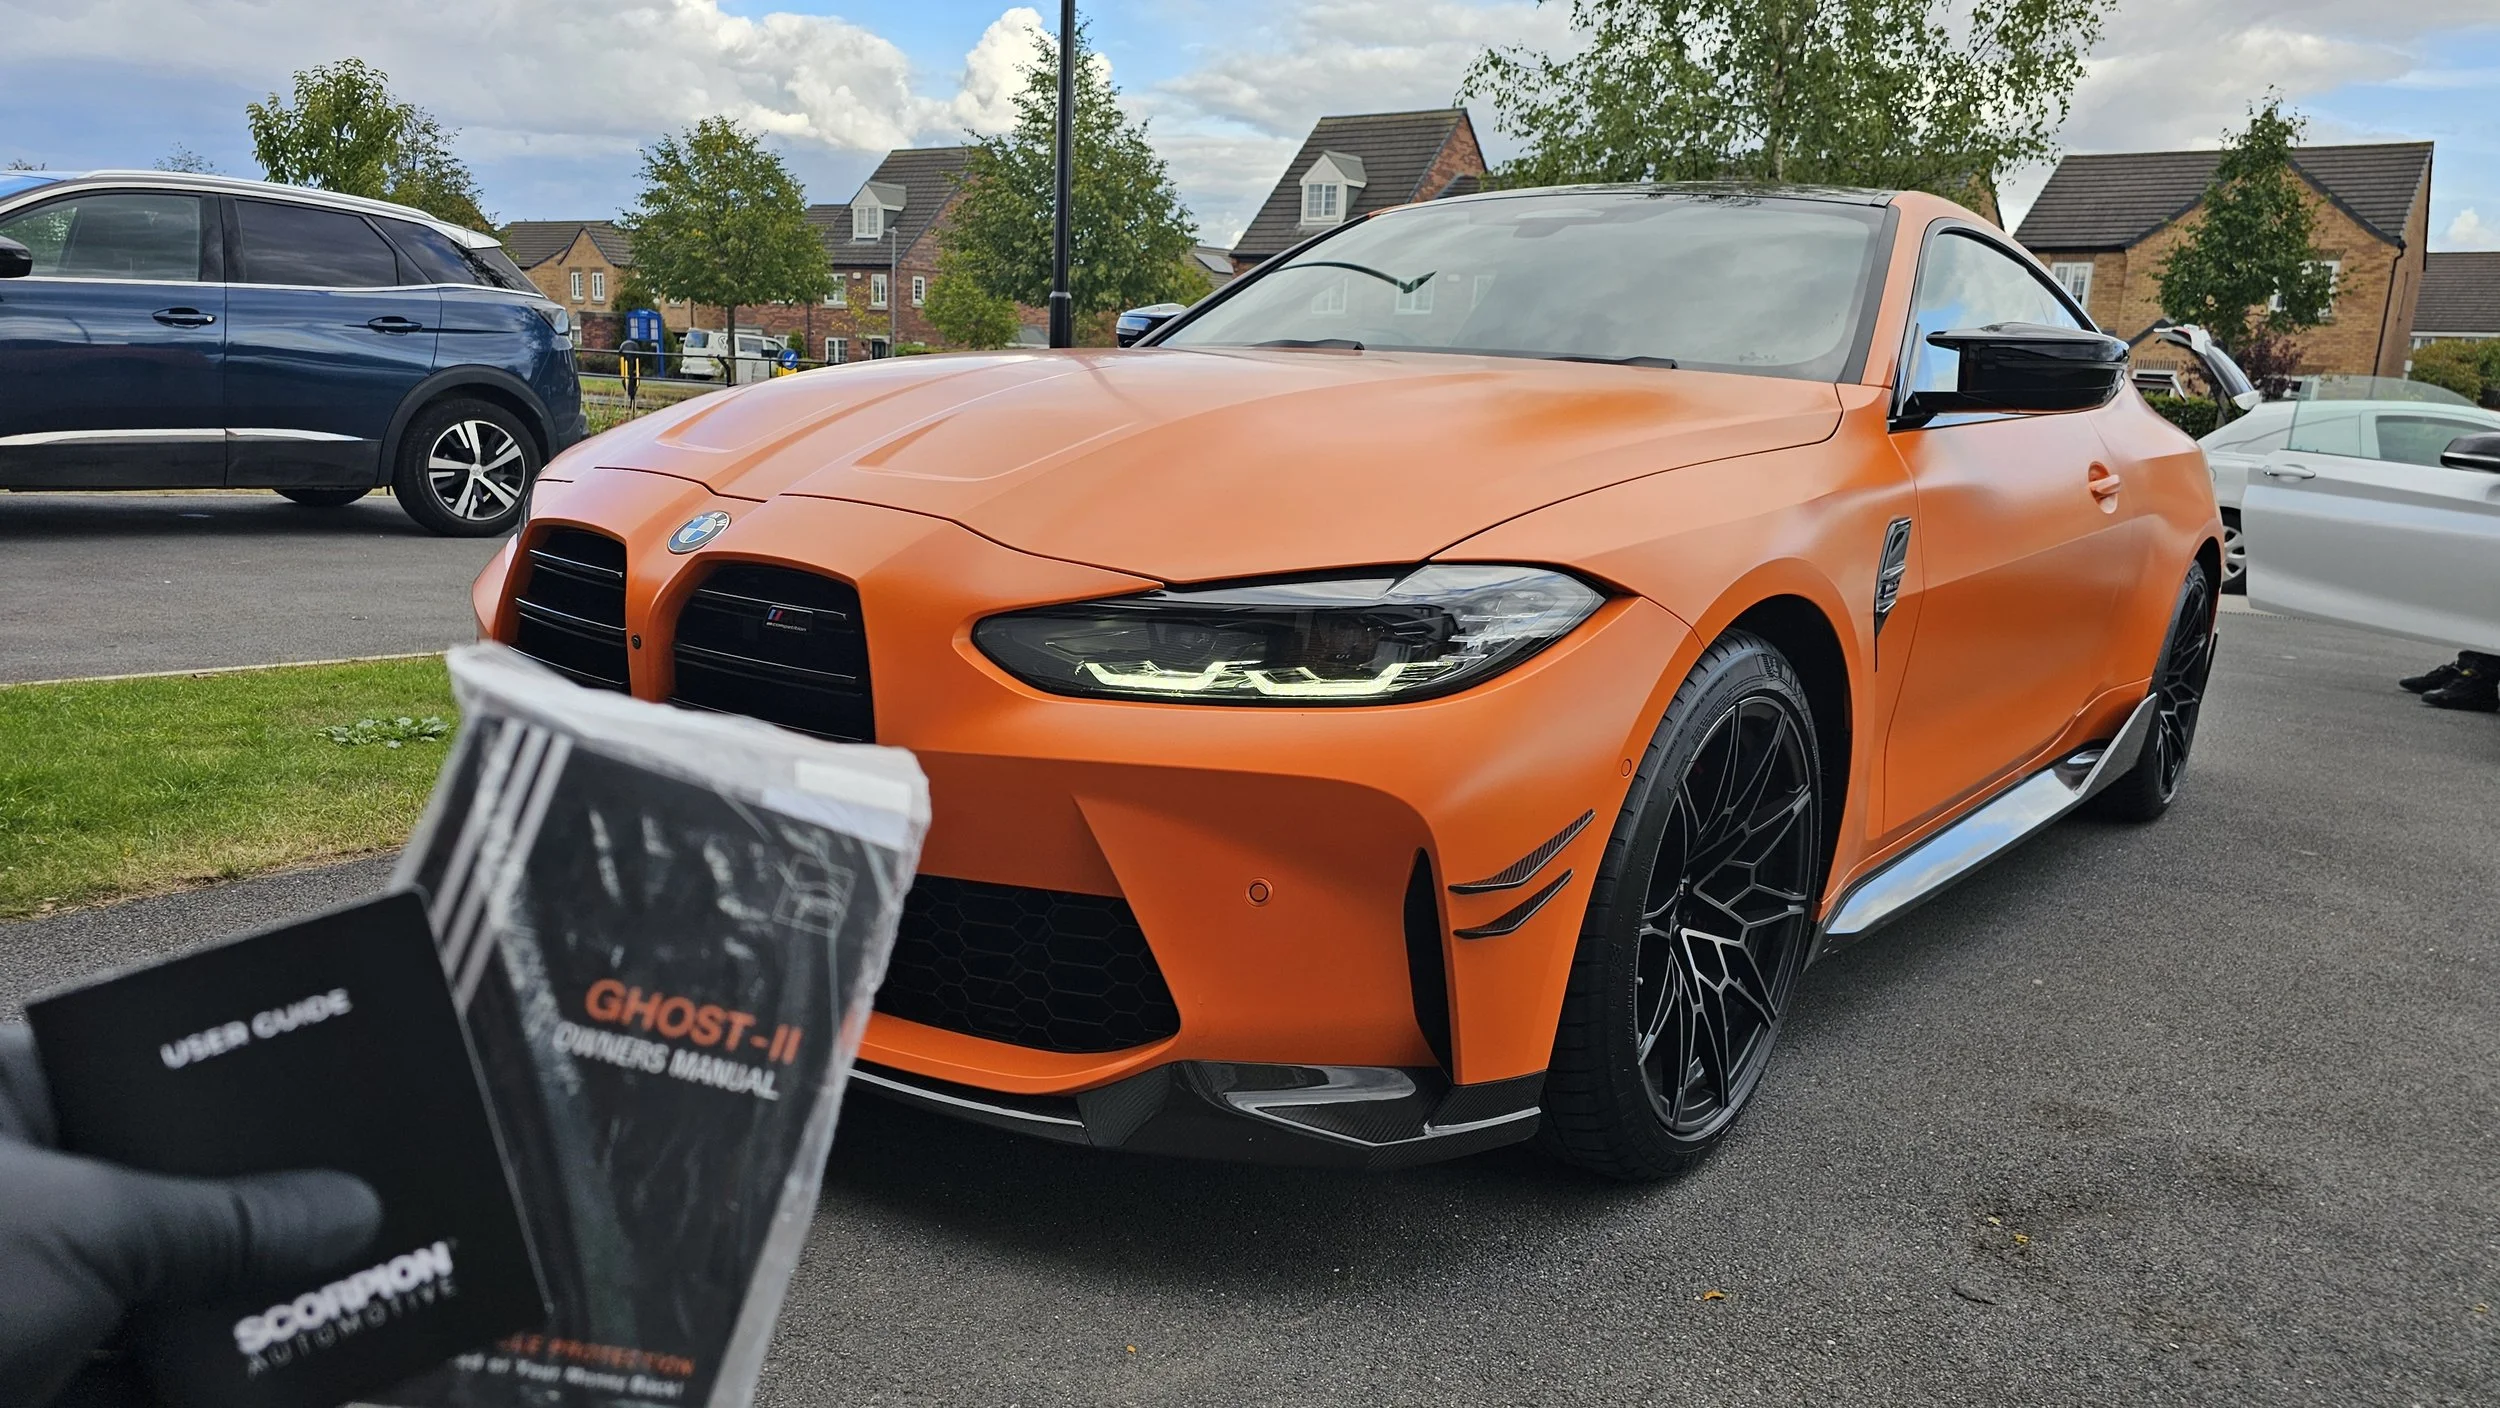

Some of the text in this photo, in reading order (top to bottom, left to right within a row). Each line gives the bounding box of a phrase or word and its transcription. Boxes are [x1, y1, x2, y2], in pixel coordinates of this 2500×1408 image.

[160, 988, 353, 1069] USER GUIDE
[552, 1020, 780, 1101] OWNERS MANUAL
[584, 978, 803, 1065] GHOST-II
[233, 1241, 453, 1355] SCORPION
[246, 1276, 456, 1381] AUTOMOTIVE
[515, 1359, 561, 1382] Your
[564, 1365, 629, 1392] Money
[548, 1338, 696, 1377] PROTECTION
